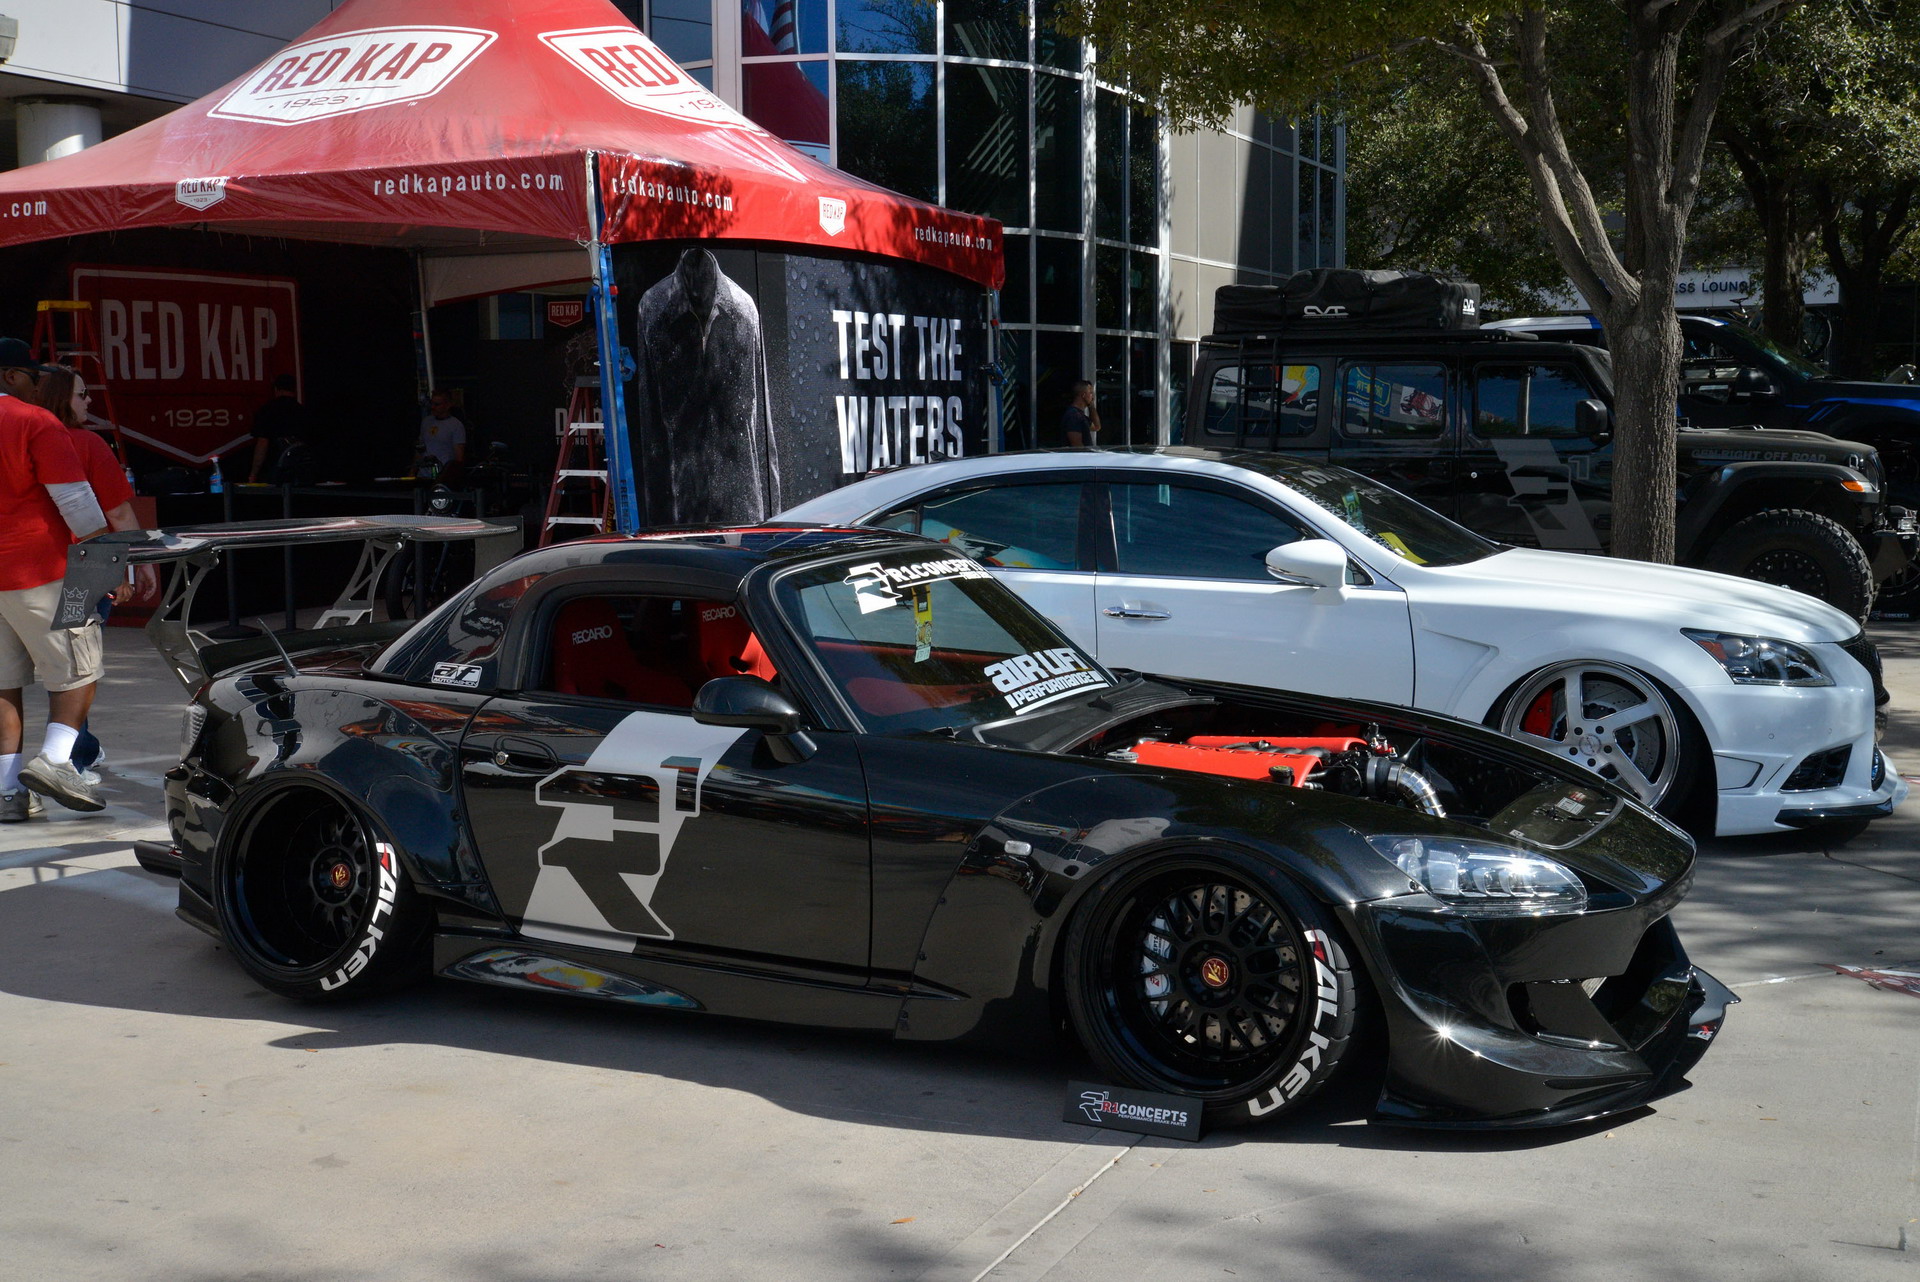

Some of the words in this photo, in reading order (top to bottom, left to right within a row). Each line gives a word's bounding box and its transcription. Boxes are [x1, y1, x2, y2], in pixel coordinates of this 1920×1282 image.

[250, 47, 352, 96] RED
[340, 42, 453, 83] KAP
[579, 44, 680, 88] RED
[282, 95, 346, 109] 1923
[373, 170, 565, 197] redkapauto.com
[611, 175, 734, 212] redkapauto.com
[914, 226, 993, 251] redkapauto.com
[551, 304, 564, 317] RED
[566, 304, 579, 316] KAP
[101, 299, 186, 381] RED
[199, 303, 278, 381] KAP
[832, 309, 906, 381] TEST
[913, 315, 962, 381] THE
[164, 408, 231, 428] 1923
[835, 395, 964, 474] WATERS
[702, 605, 736, 623] RECARO
[572, 624, 613, 646] RECARO
[319, 842, 398, 991] FALKEN
[1247, 926, 1339, 1117] FALKEN
[1118, 1113, 1153, 1123] PERFORMANCE
[1153, 1117, 1170, 1125] BRAKE
